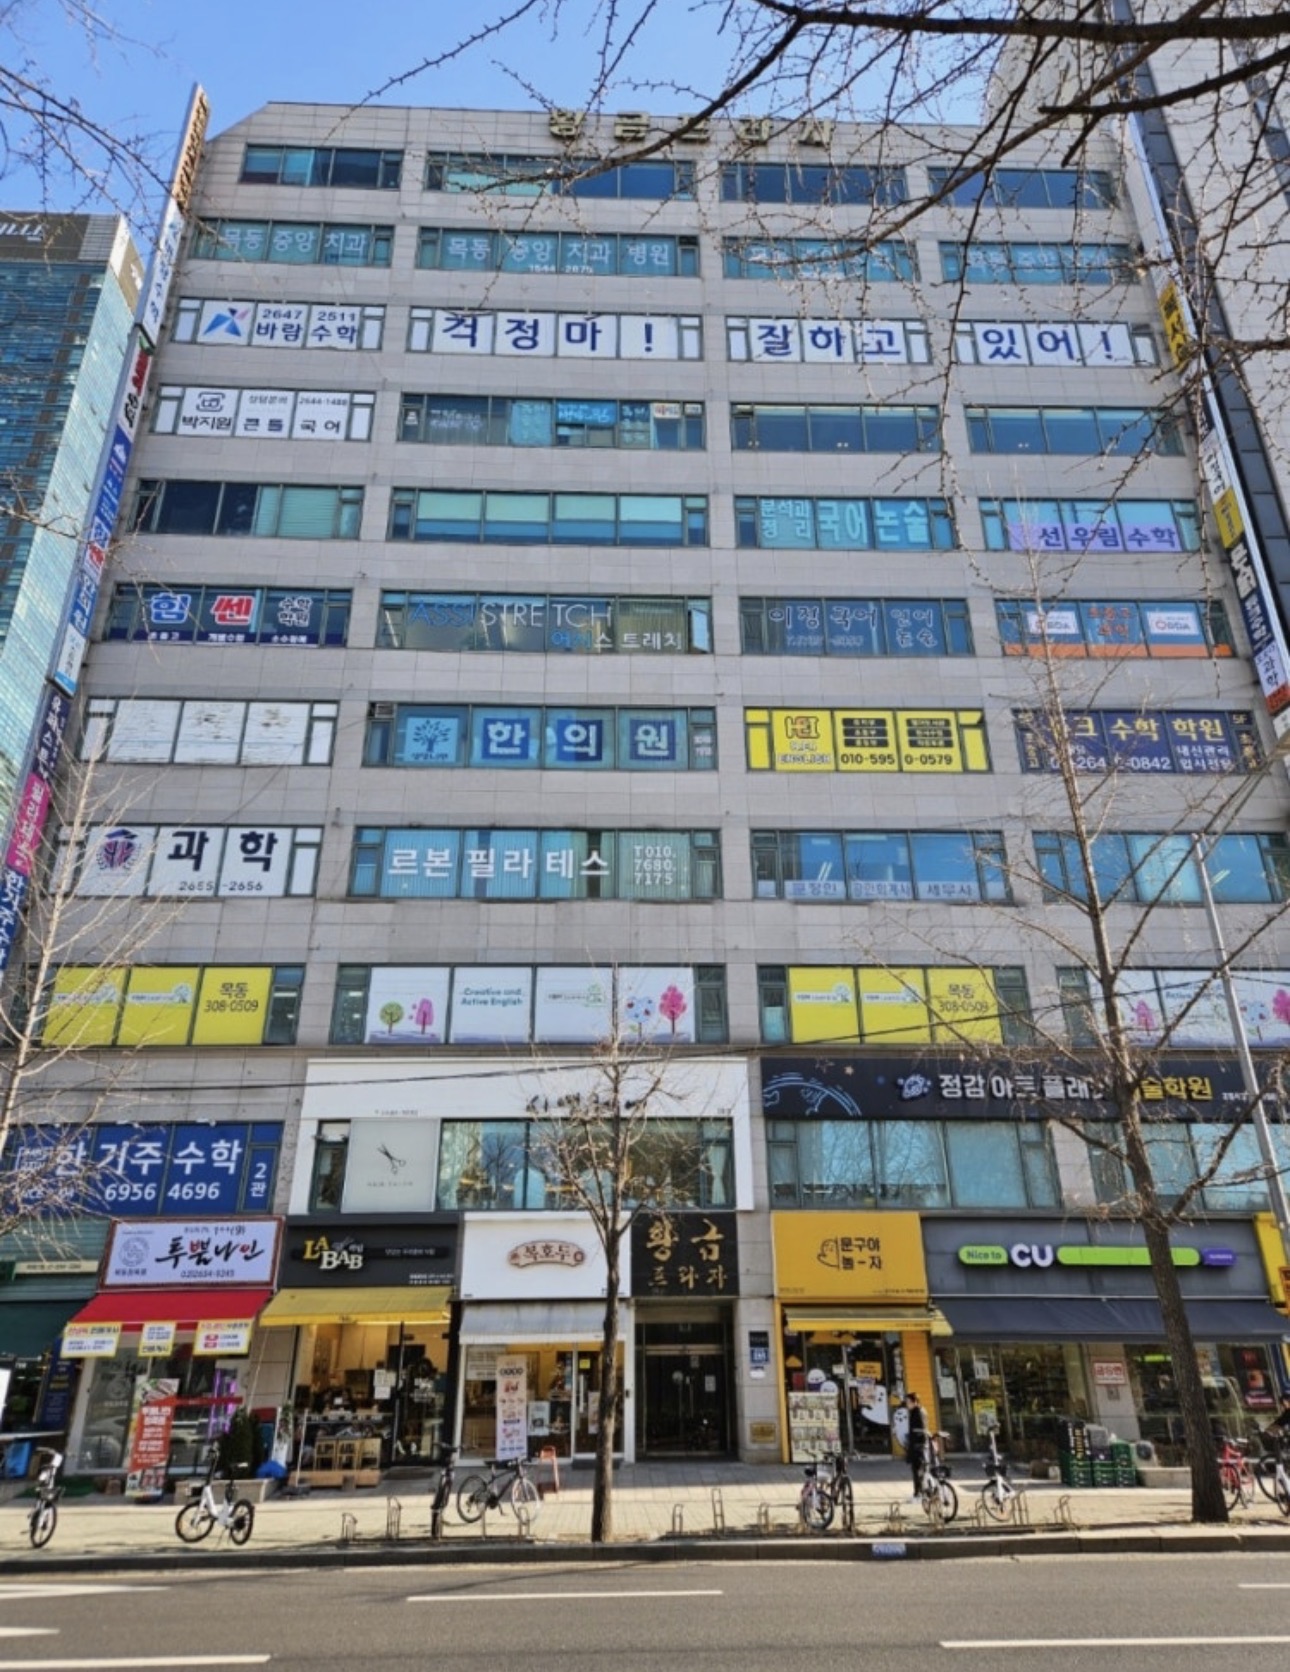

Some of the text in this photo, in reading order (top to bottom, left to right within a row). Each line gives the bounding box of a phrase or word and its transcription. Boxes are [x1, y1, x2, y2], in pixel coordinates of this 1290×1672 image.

[223, 230, 368, 257] 목동 중앙 치과
[447, 238, 670, 267] 목동 중앙 치과 병원
[262, 308, 357, 323] 2647 2511
[757, 323, 903, 363] 잘하고
[181, 416, 233, 431] 박지원
[300, 419, 342, 434] 국어
[486, 722, 671, 757] 한의원
[1111, 719, 1160, 741] 수학
[1172, 718, 1226, 741] 학원
[167, 830, 278, 873] 과학
[387, 847, 611, 879] 르본 필라테스
[633, 872, 674, 886] 7175
[926, 884, 973, 897] 세무사
[220, 982, 249, 998] 목동
[204, 999, 259, 1013] 308-0509
[938, 1000, 989, 1014] 308-0509
[938, 1073, 987, 1099] 정감
[104, 1182, 221, 1202] 6956 4696
[154, 1235, 265, 1270] 투뿔나인
[303, 1235, 330, 1260] LA
[645, 1218, 725, 1262] 황금
[319, 1250, 364, 1270] BAB
[1010, 1243, 1054, 1268] CU
